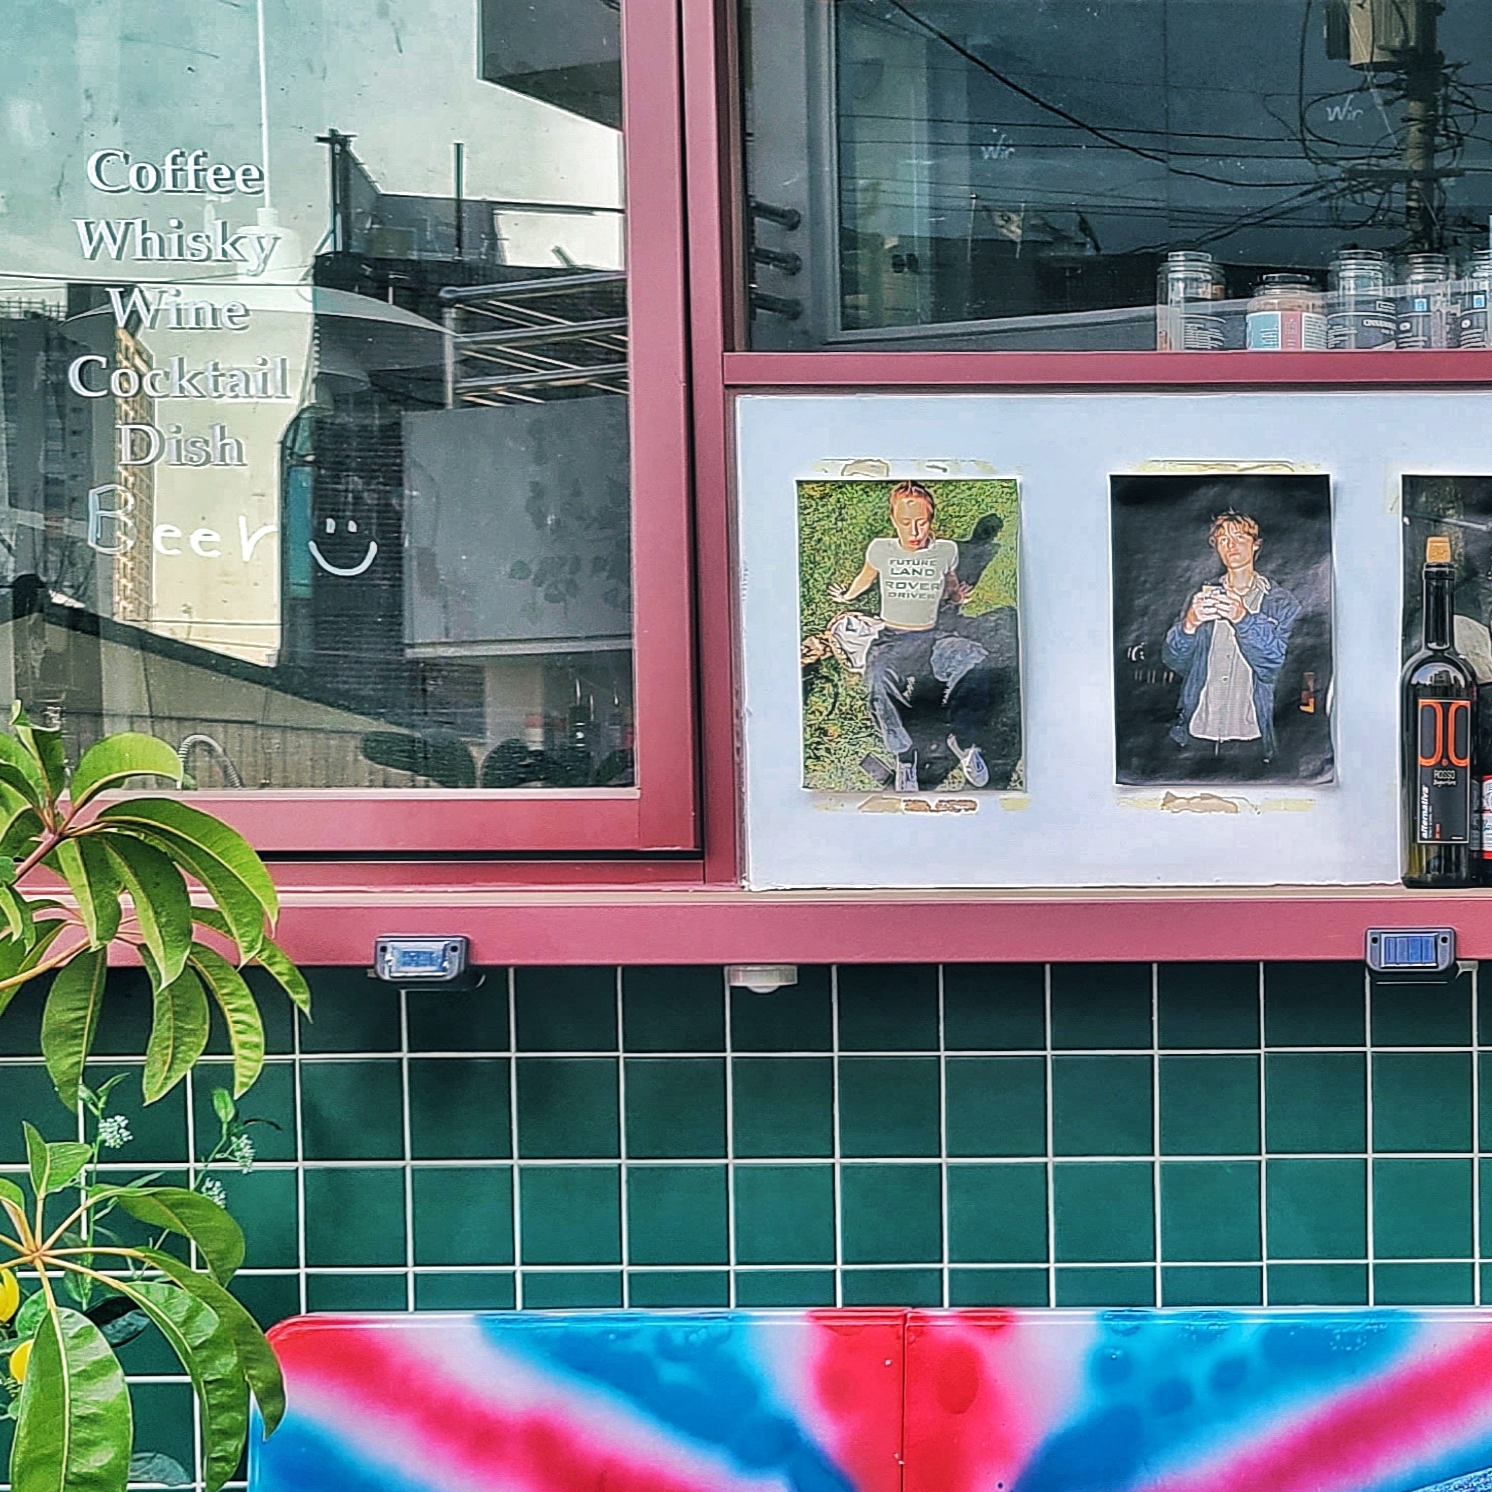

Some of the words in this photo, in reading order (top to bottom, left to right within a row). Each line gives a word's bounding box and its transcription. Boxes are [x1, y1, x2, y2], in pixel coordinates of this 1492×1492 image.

[86, 148, 265, 194] Coffee
[72, 218, 282, 277] Whisky
[105, 287, 251, 332] Wine
[68, 355, 293, 400] Cocktail
[115, 423, 248, 467] Dish
[87, 484, 280, 563] Beer
[889, 559, 938, 567] FUTURE
[890, 567, 936, 577] LAND
[885, 581, 941, 591] ROVER
[887, 591, 937, 600] DRIVER
